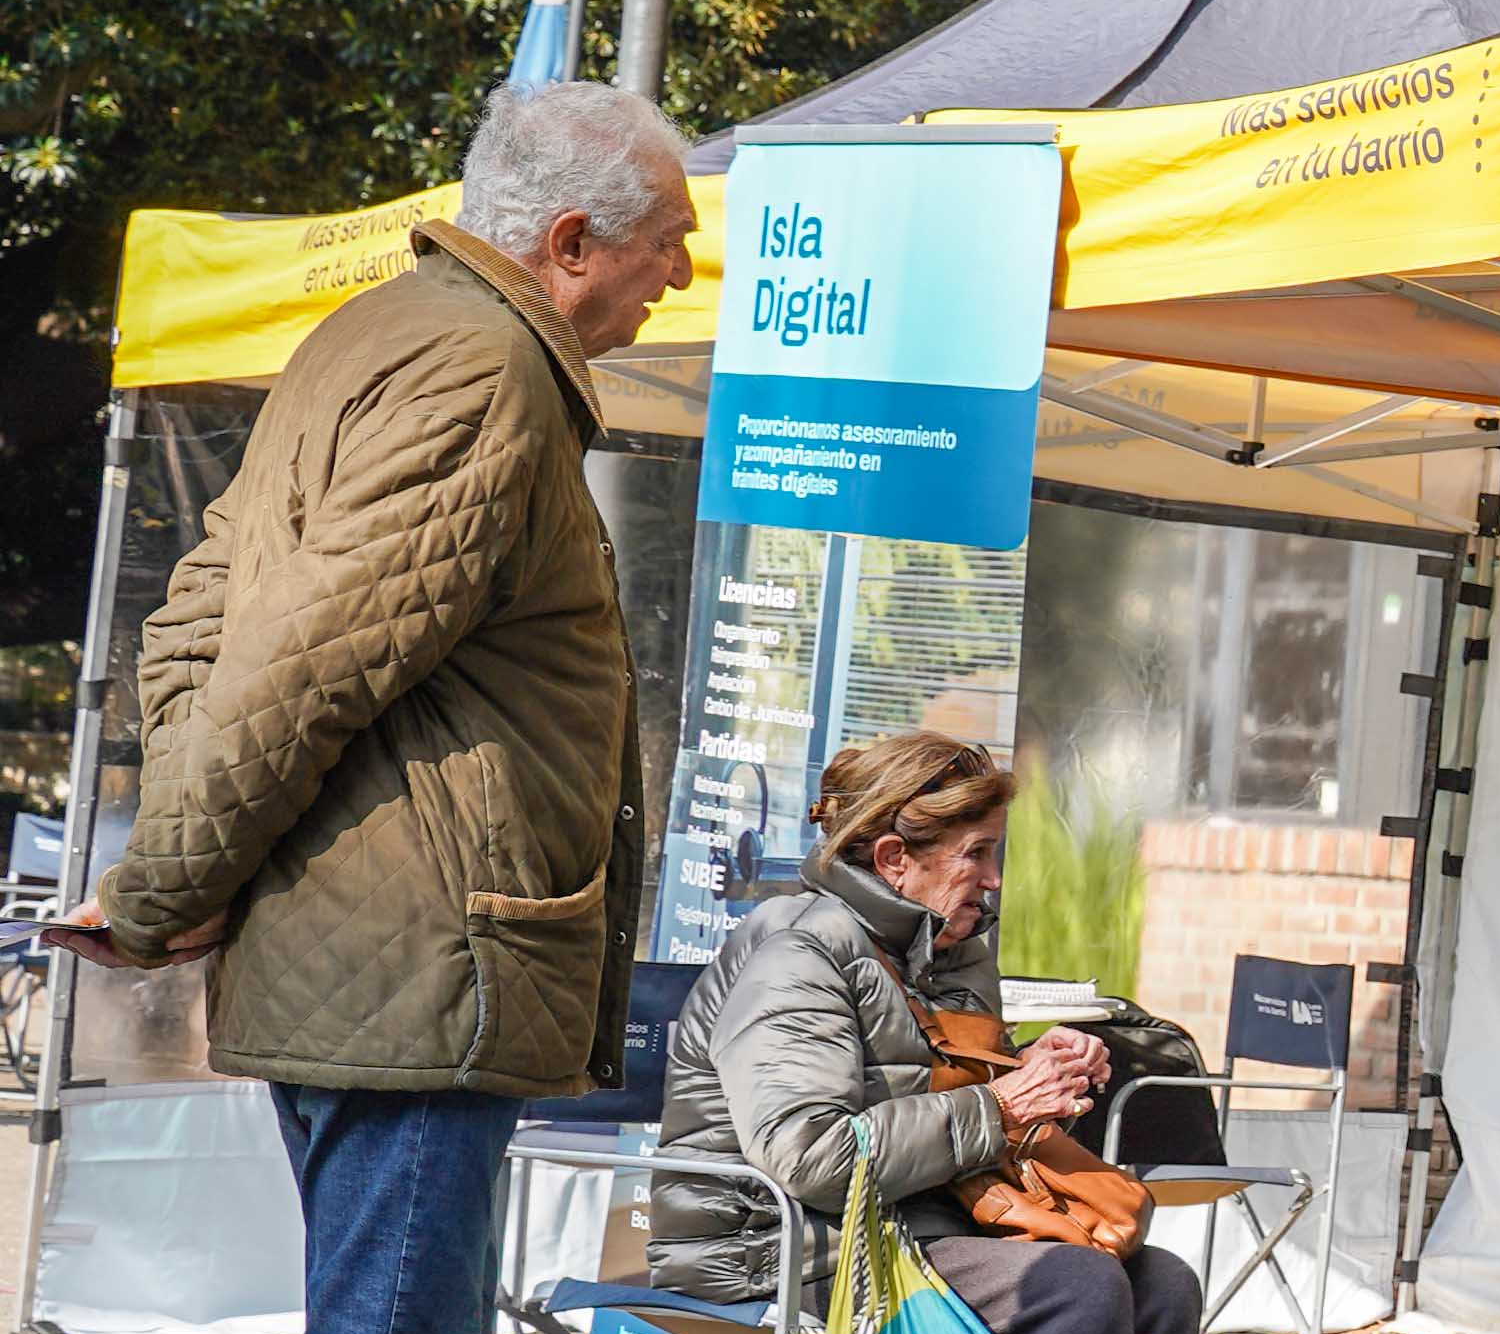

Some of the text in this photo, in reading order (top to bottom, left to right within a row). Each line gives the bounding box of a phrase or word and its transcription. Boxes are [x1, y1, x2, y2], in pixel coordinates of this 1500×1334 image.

[1298, 63, 1455, 121] servicios
[1256, 120, 1443, 189] en tu barrio
[760, 203, 822, 258] Isla
[753, 276, 871, 346] Digital
[842, 424, 957, 450] asesoramiento
[734, 444, 881, 471] y acompañamiento en
[719, 576, 797, 609] Licencias
[700, 730, 767, 764] Partidas
[680, 859, 727, 891] SUBE
